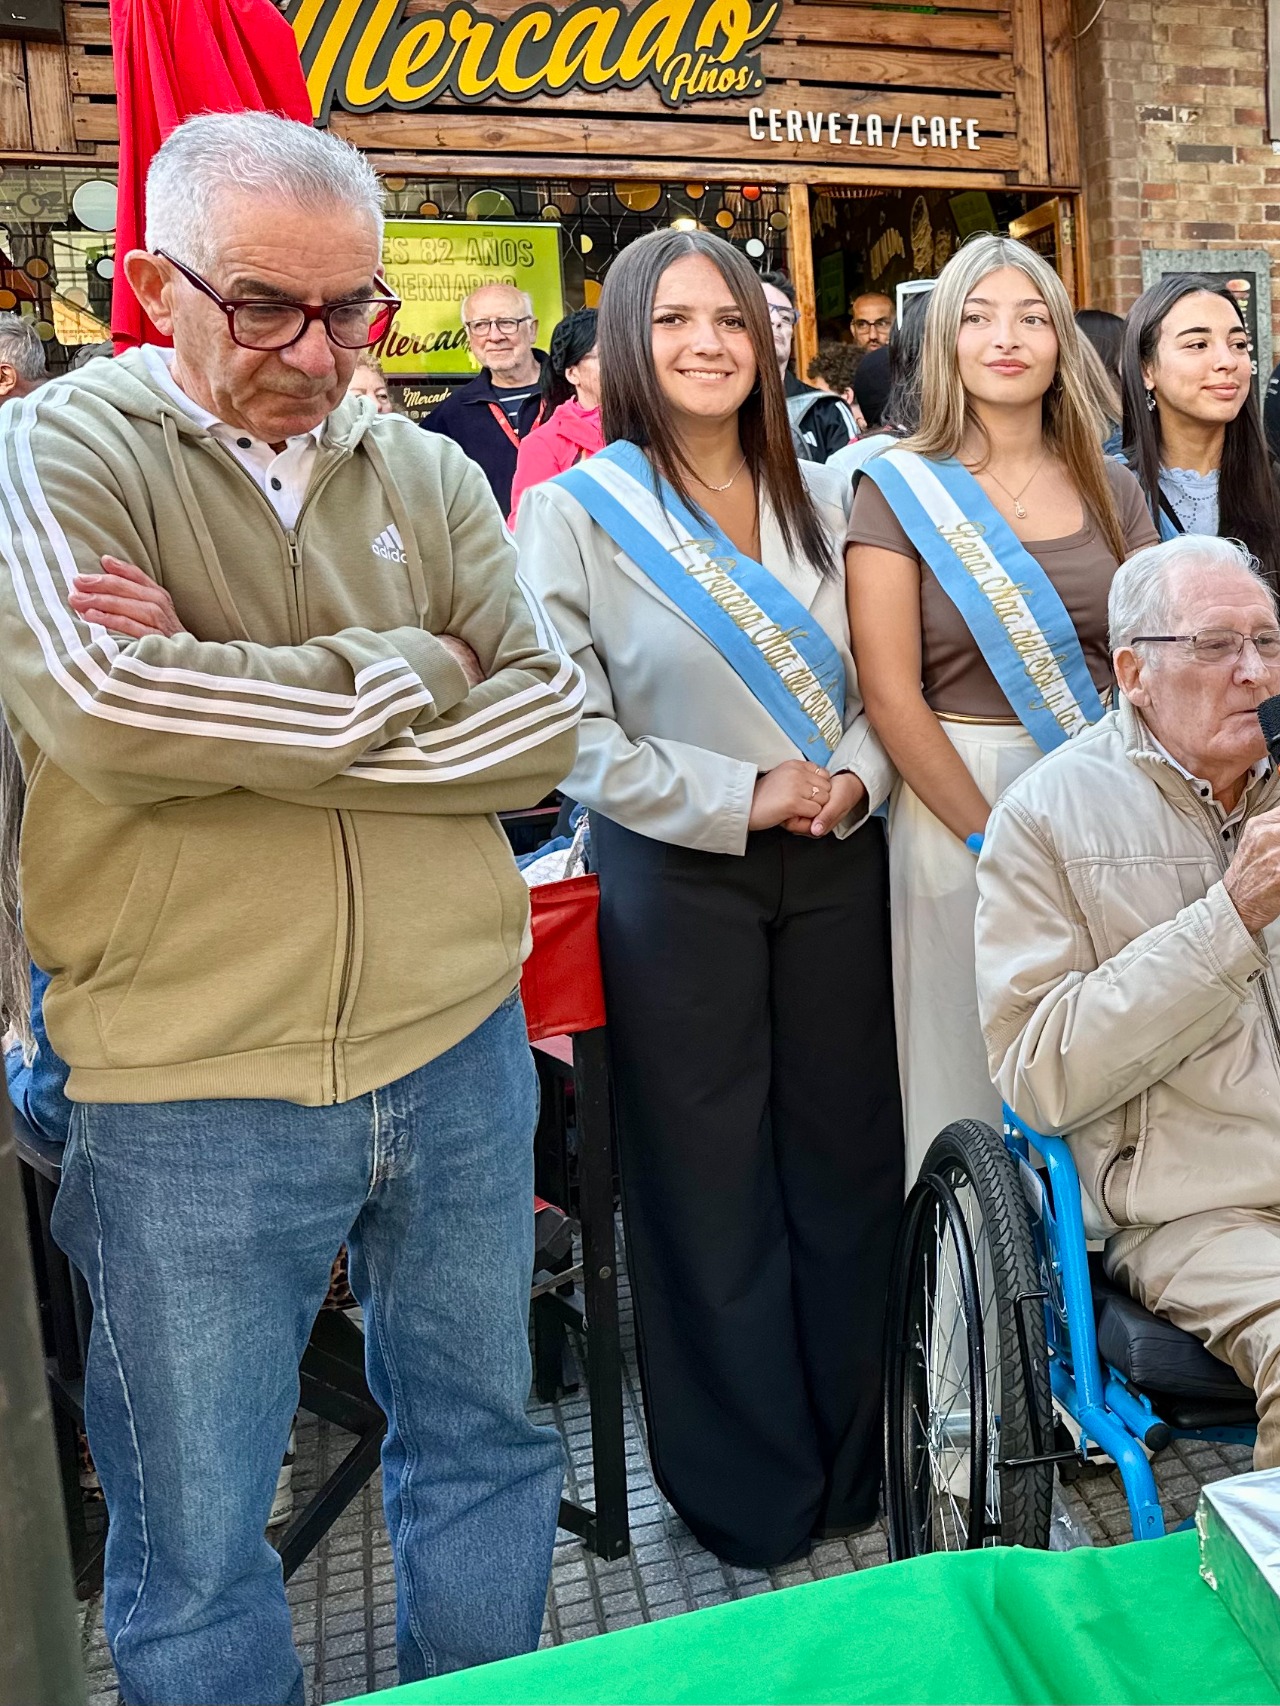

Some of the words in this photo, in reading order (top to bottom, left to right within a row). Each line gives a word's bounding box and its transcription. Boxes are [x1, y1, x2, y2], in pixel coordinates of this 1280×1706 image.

[291, 0, 778, 118] Mercado
[421, 237, 453, 265] 82
[466, 231, 535, 267] AÑOS
[936, 521, 992, 576] Reina
[685, 557, 766, 631] Princesa
[981, 576, 1033, 630] Nac.
[1008, 629, 1057, 659] del
[1024, 653, 1071, 692] Sol
[1028, 691, 1064, 711] y
[1056, 700, 1083, 729] la
